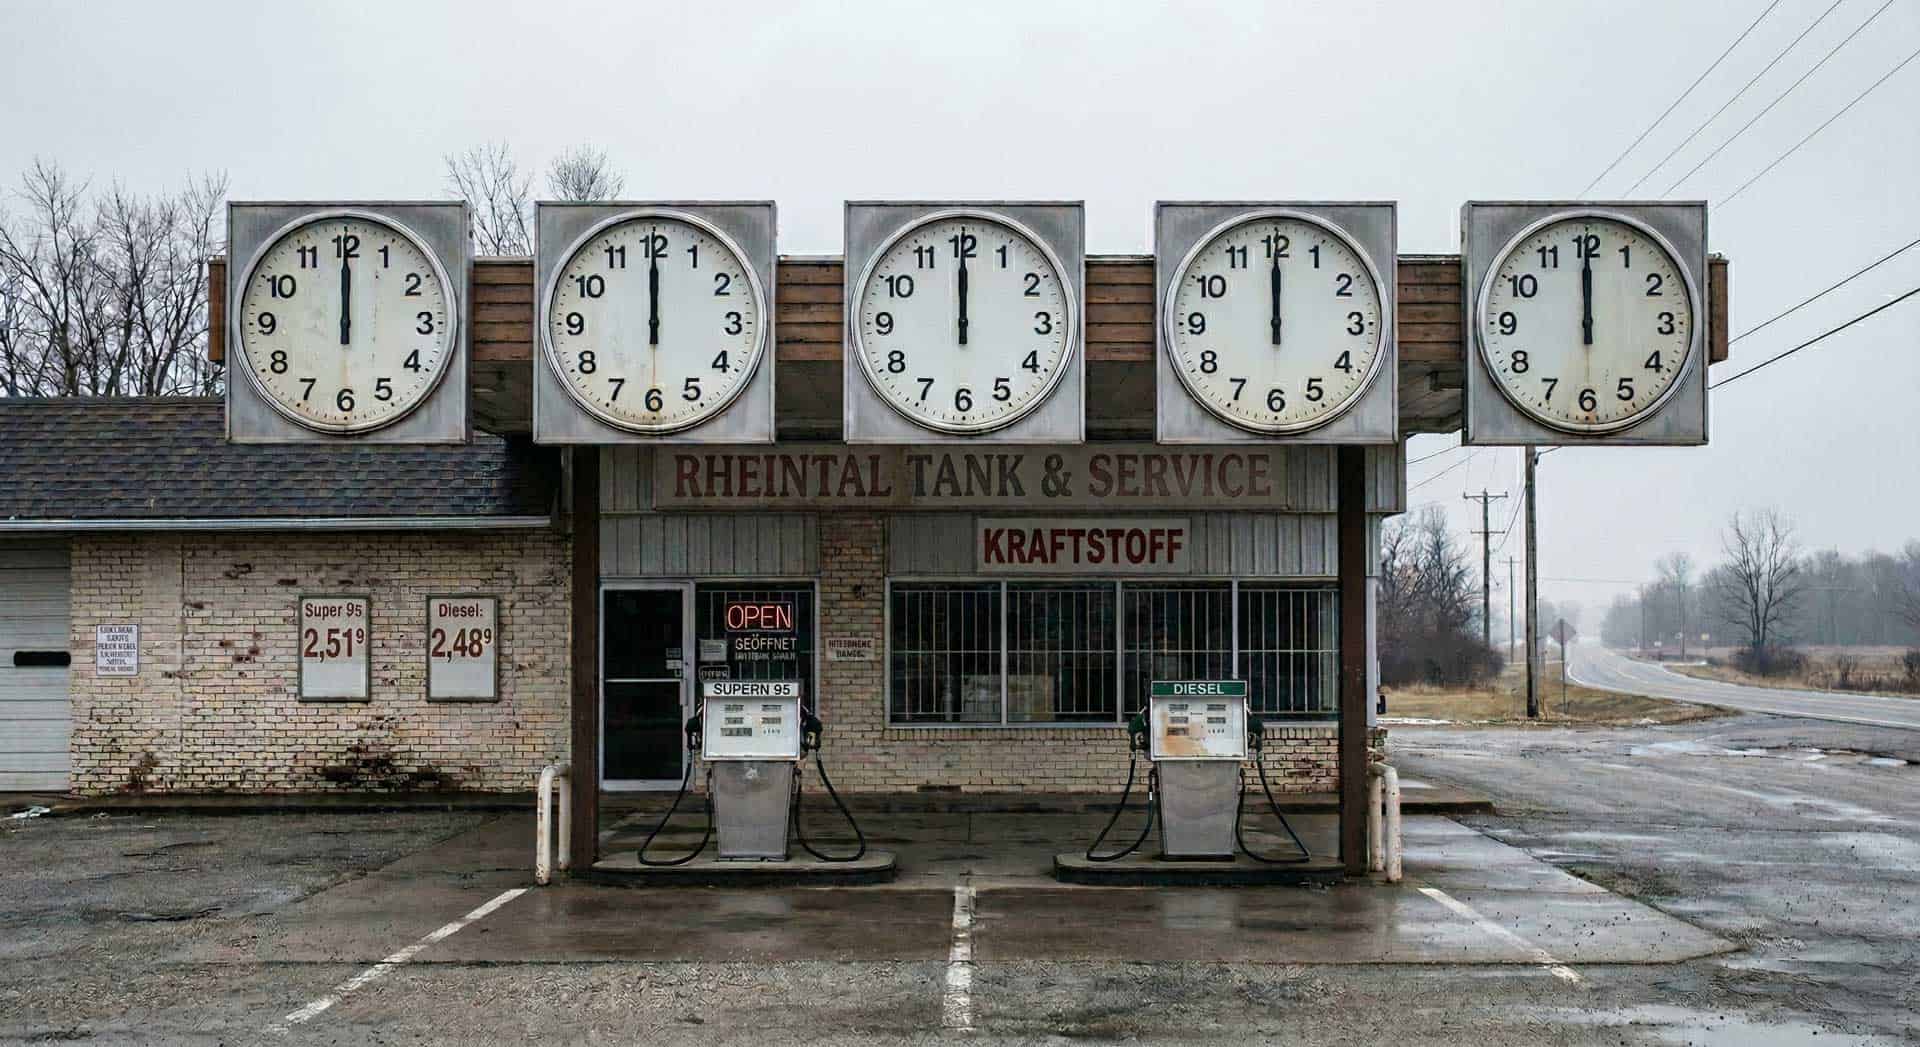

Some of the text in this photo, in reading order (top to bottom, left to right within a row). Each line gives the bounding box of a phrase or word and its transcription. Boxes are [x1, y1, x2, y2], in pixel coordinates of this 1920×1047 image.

[297, 245, 317, 268] 11
[332, 235, 360, 258] 12
[378, 245, 388, 268] 1
[604, 245, 625, 268] 11
[640, 235, 668, 258] 12
[687, 245, 697, 268] 1
[913, 245, 934, 268] 11
[949, 235, 976, 258] 12
[996, 245, 1006, 268] 1
[1225, 245, 1247, 268] 11
[1261, 235, 1289, 258] 12
[1309, 245, 1319, 268] 1
[1537, 245, 1558, 268] 11
[1572, 235, 1600, 258] 12
[1619, 245, 1630, 268] 1
[267, 275, 296, 298] 10
[405, 273, 421, 296] 2
[576, 275, 604, 298] 10
[714, 273, 730, 296] 2
[885, 275, 913, 298] 10
[1024, 273, 1040, 296] 2
[1197, 275, 1226, 298] 10
[1336, 273, 1352, 296] 2
[1508, 274, 1537, 298] 10
[1646, 273, 1663, 296] 2
[258, 312, 276, 336] 9
[416, 312, 433, 335] 3
[566, 312, 584, 335] 9
[725, 312, 742, 335] 3
[876, 312, 893, 335] 9
[1035, 312, 1052, 335] 3
[1188, 312, 1205, 335] 9
[1347, 312, 1364, 336] 3
[1499, 312, 1517, 335] 9
[1657, 312, 1675, 335] 3
[271, 350, 288, 374] 8
[404, 349, 421, 373] 4
[579, 351, 596, 374] 8
[712, 351, 730, 373] 4
[888, 350, 905, 373] 8
[1022, 350, 1040, 373] 4
[1200, 350, 1217, 373] 8
[1334, 350, 1352, 373] 4
[1511, 350, 1529, 373] 8
[1644, 350, 1663, 373] 4
[300, 378, 316, 401] 7
[337, 389, 354, 412] 6
[375, 378, 392, 401] 5
[608, 378, 624, 401] 7
[645, 389, 663, 412] 6
[683, 378, 700, 401] 5
[917, 378, 934, 401] 7
[955, 389, 972, 412] 6
[993, 378, 1010, 401] 5
[1229, 378, 1246, 401] 7
[1267, 389, 1285, 412] 6
[1306, 378, 1323, 401] 5
[1541, 378, 1558, 401] 7
[1579, 389, 1596, 412] 6
[1617, 378, 1634, 401] 5
[674, 453, 1273, 498] RHEINTAL TANK & SERVICE
[984, 527, 1185, 564] KRAFTSTOFF
[305, 602, 363, 620] Super 95
[438, 602, 484, 618] Diesel:
[727, 604, 791, 629] OPEN
[735, 633, 797, 650] GEÖFFNET
[713, 683, 791, 695] SUPERN 95
[1173, 683, 1225, 695] DIESEL
